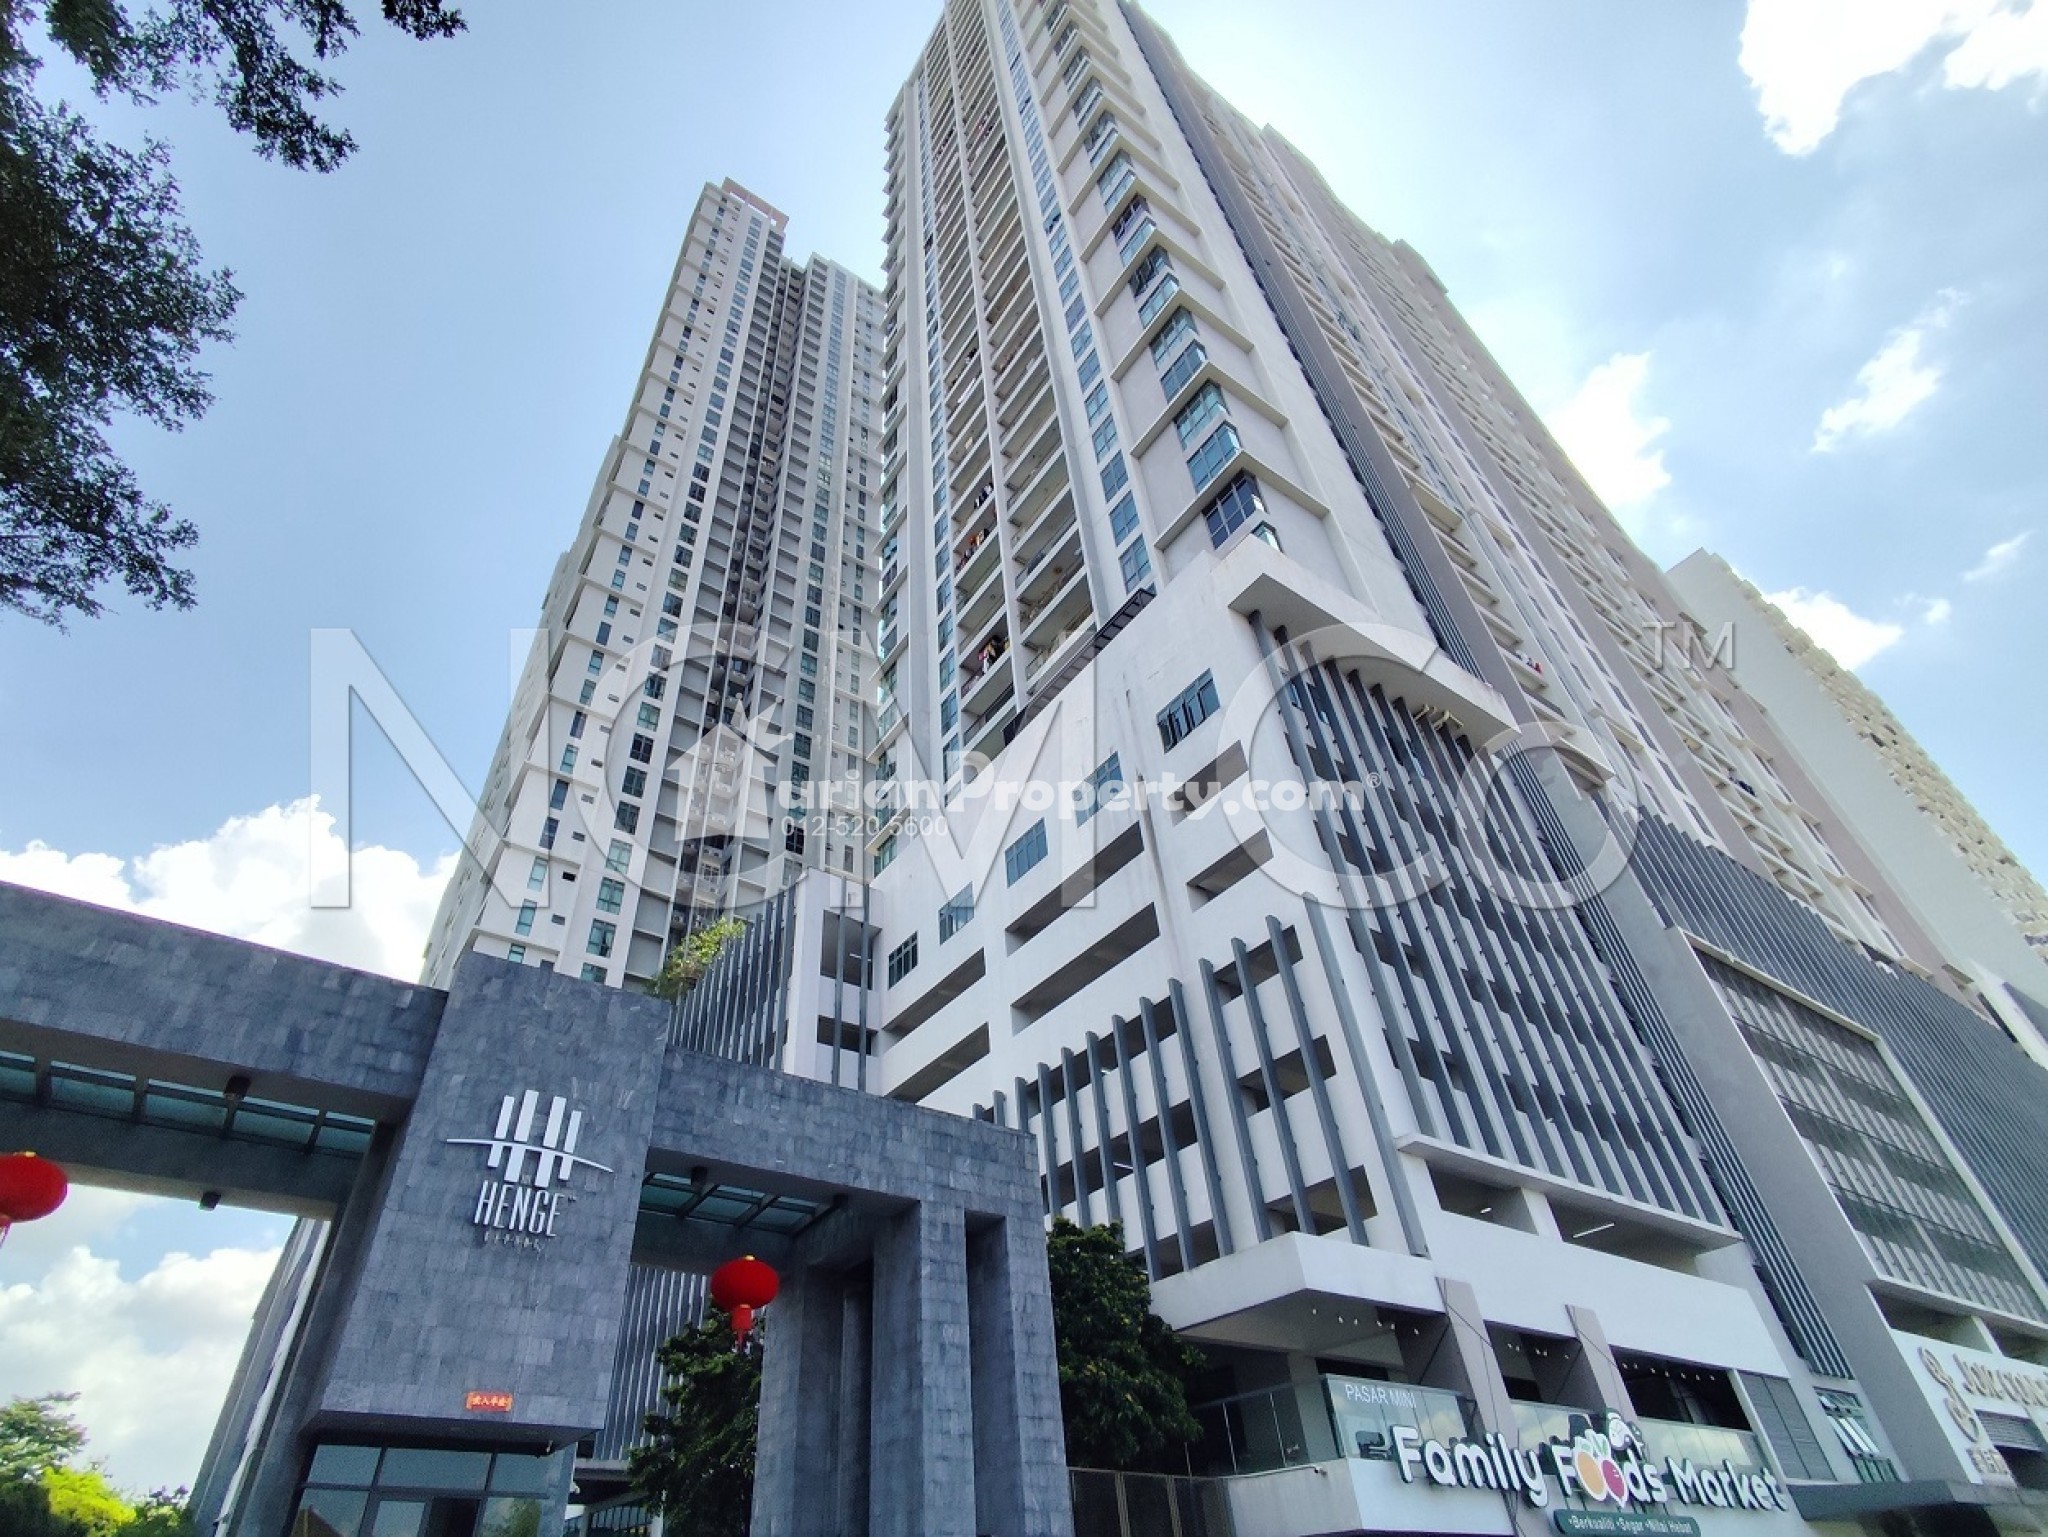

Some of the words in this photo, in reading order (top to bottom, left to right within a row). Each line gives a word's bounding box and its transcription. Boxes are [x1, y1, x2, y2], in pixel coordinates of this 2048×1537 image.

[474, 1179, 565, 1237] HENGE
[1344, 1384, 1389, 1405] PASAR
[1390, 1391, 1417, 1408] MINI
[1392, 1425, 1548, 1508] Family
[1666, 1456, 1788, 1511] Market
